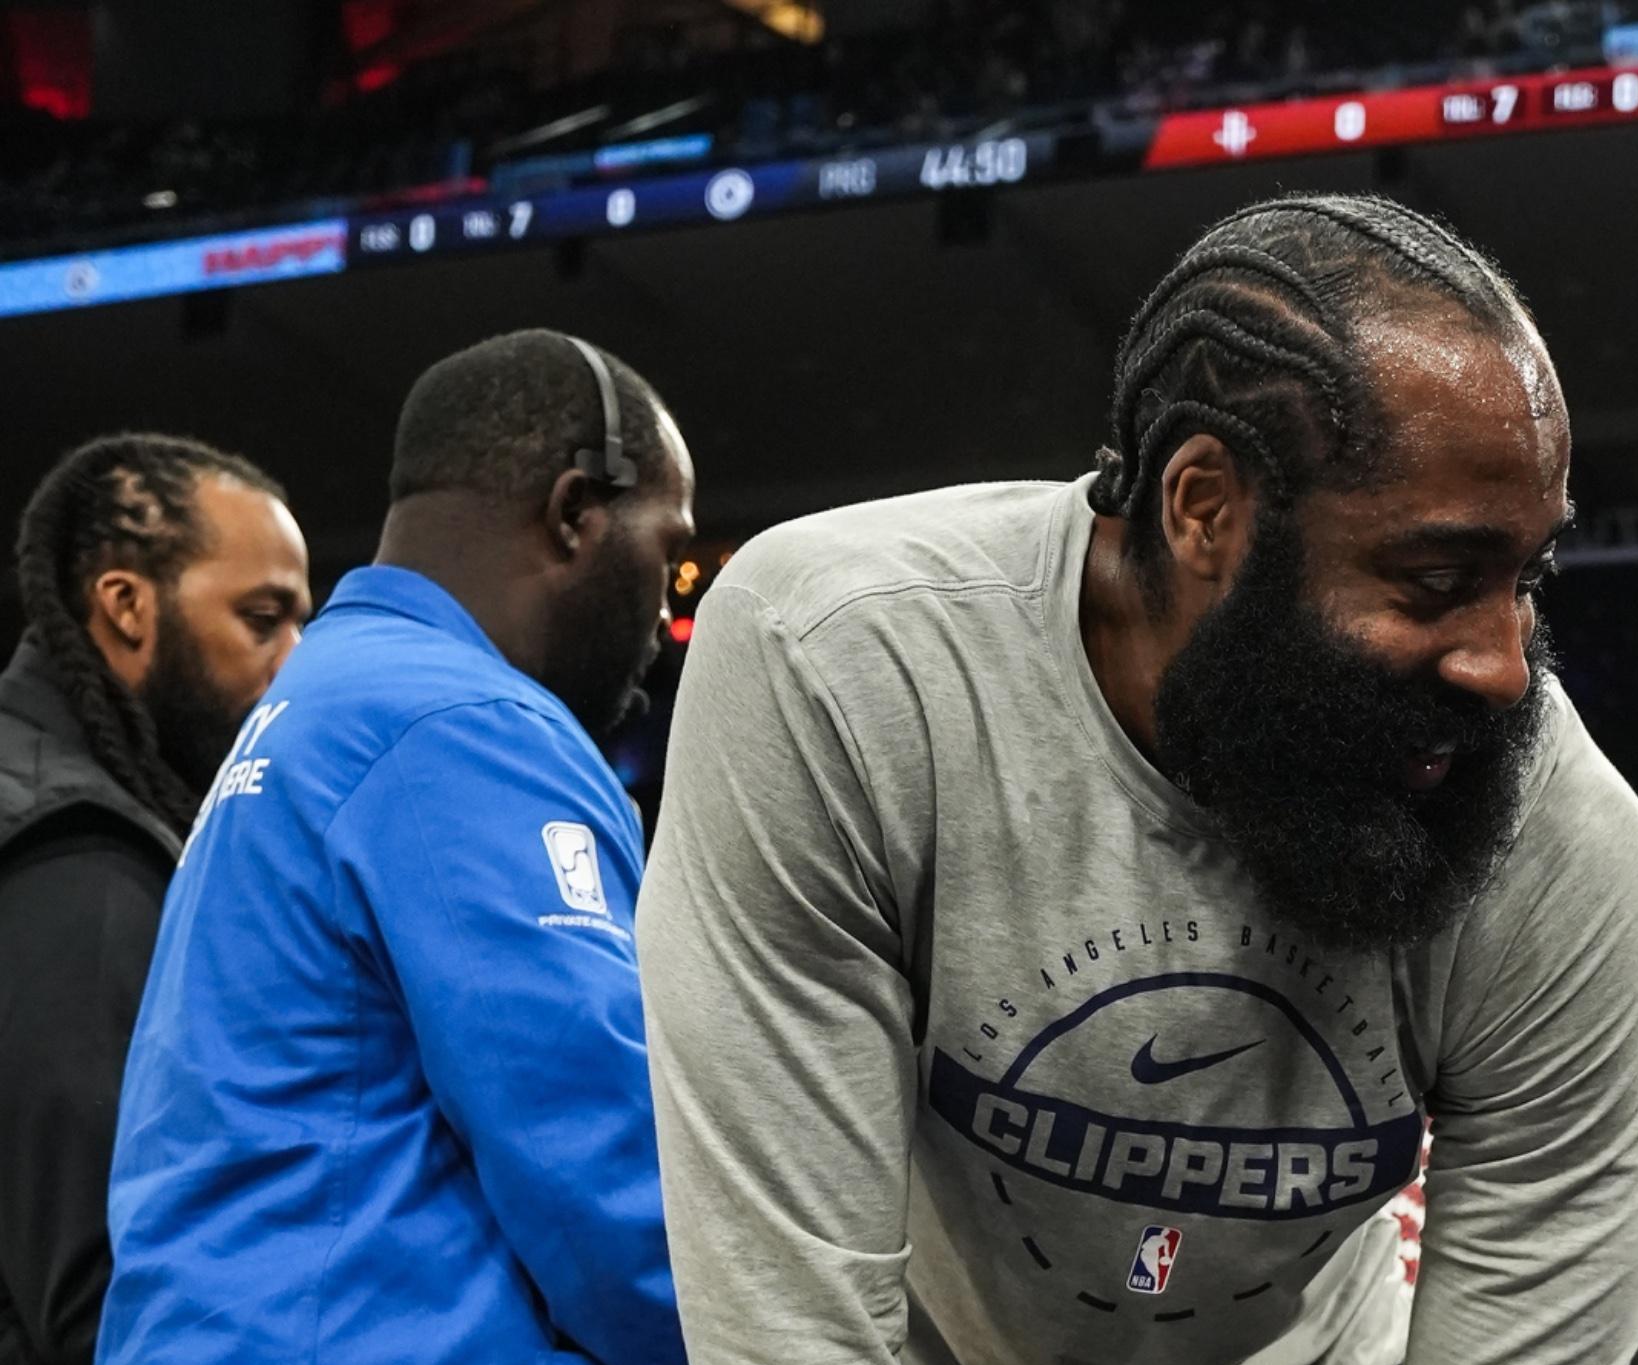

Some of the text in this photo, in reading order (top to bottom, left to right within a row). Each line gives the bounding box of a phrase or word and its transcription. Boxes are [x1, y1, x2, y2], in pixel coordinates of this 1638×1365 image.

[1333, 102, 1366, 141] 0
[1491, 84, 1519, 124] 7
[409, 213, 436, 252] 0
[509, 199, 533, 240] 7
[606, 188, 636, 227] 0
[963, 920, 1405, 1108] LOS ANGELES BASKETBALL
[970, 1091, 1380, 1211] CLIPPERS
